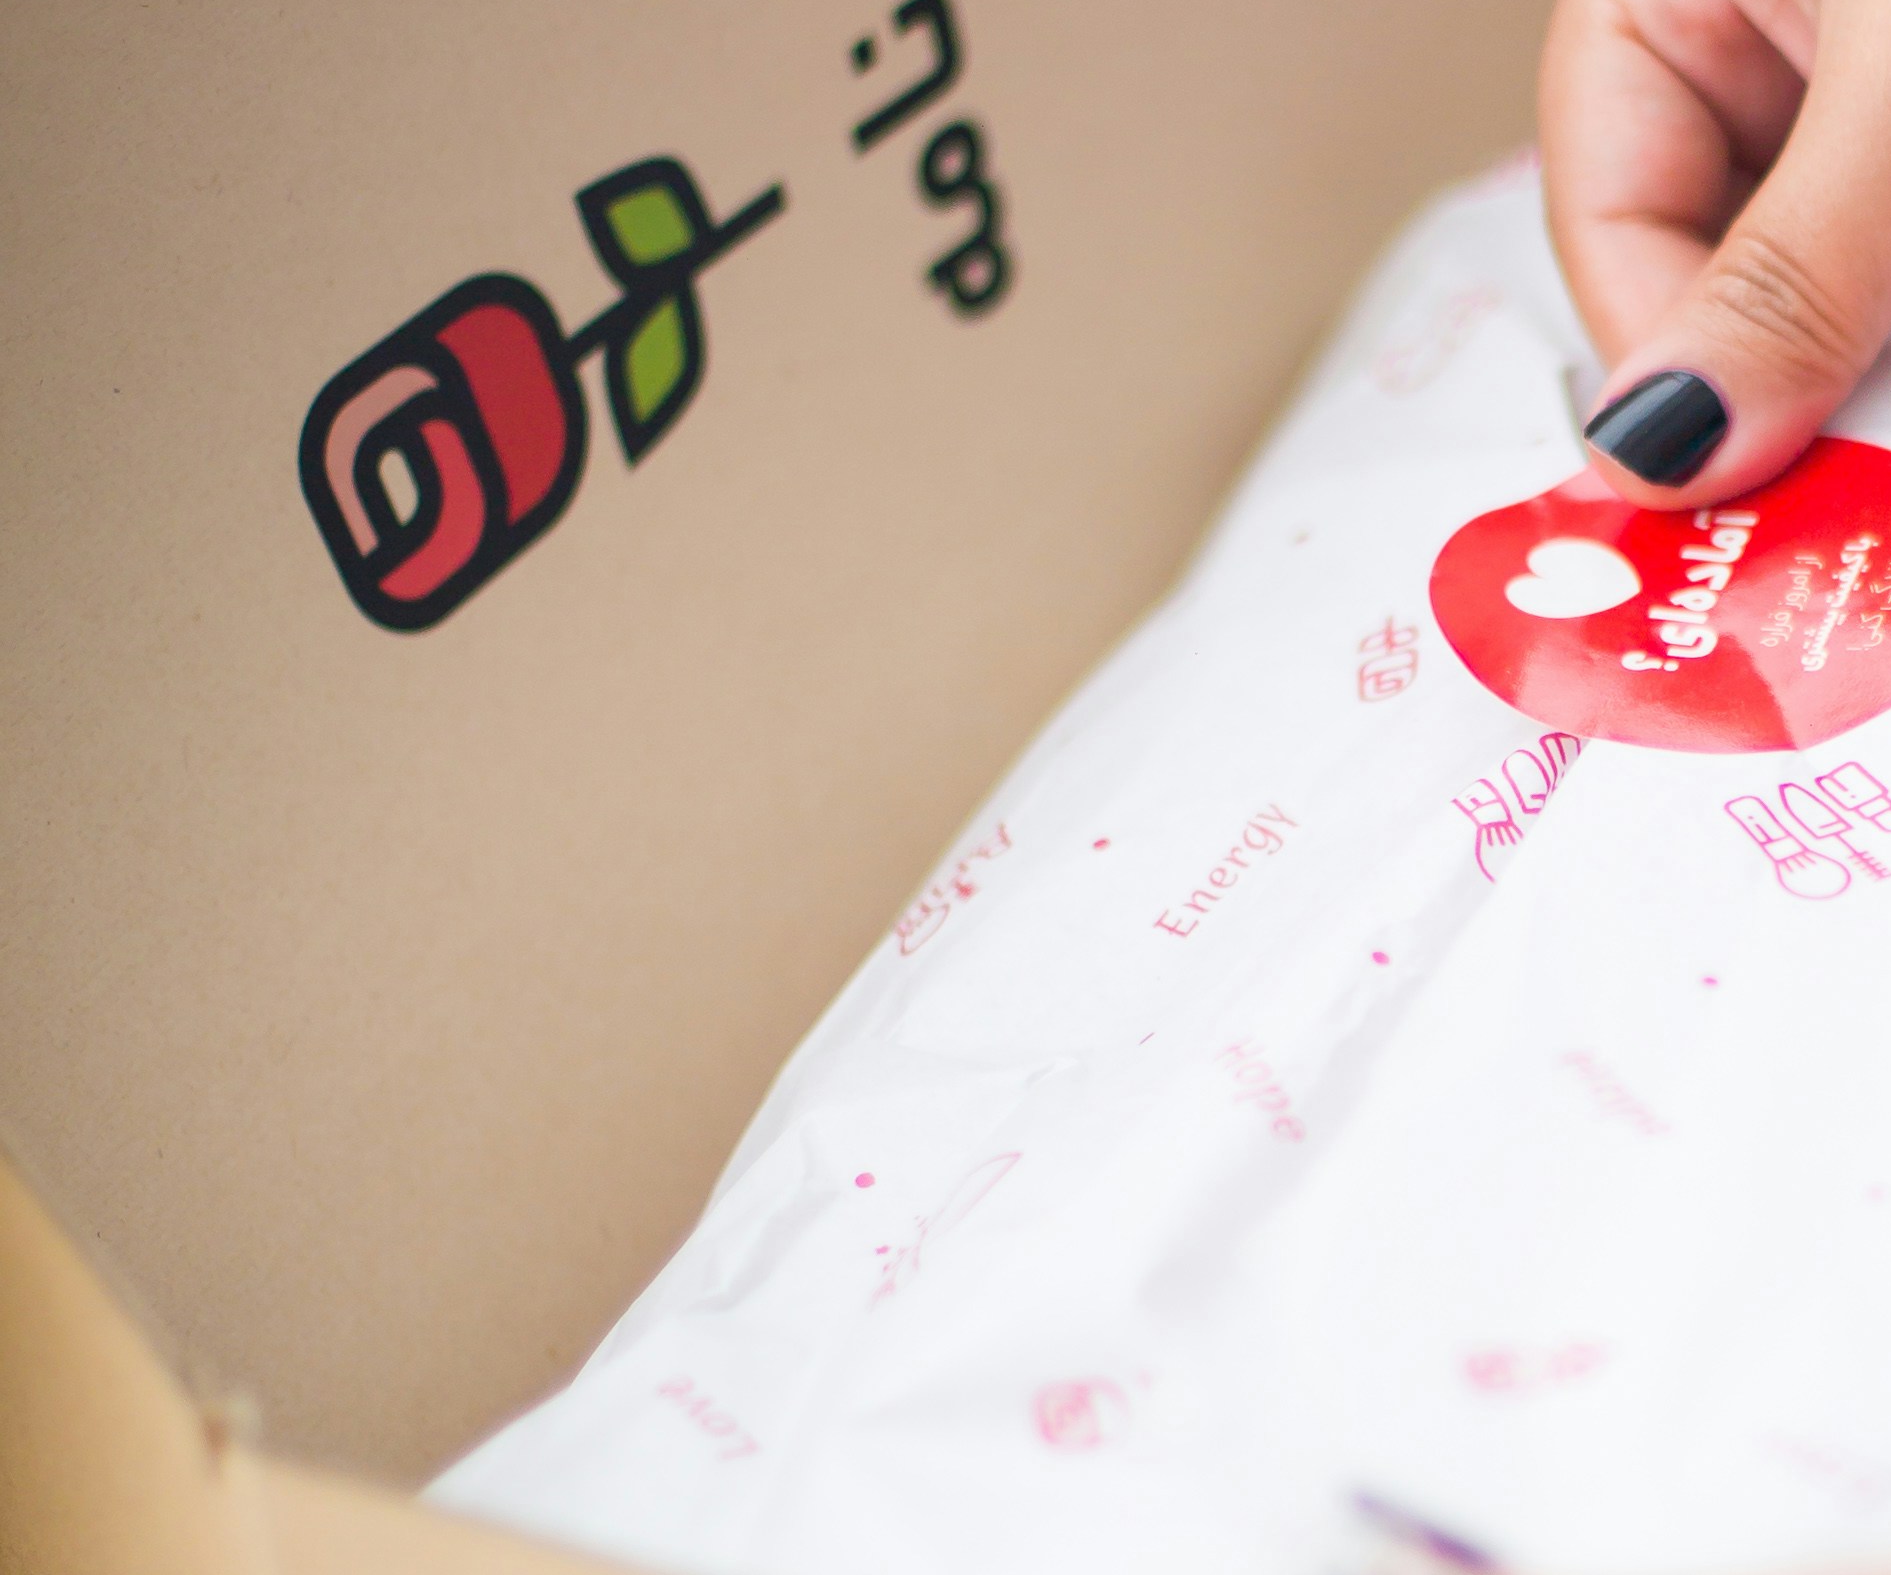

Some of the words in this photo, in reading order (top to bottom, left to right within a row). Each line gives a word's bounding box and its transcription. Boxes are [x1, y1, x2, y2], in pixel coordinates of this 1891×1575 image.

[1844, 535, 1880, 552] با
[1777, 569, 1812, 612] امروز
[1760, 610, 1793, 648] قراره
[1153, 802, 1300, 939] Energy
[1212, 1035, 1307, 1143] Hope
[655, 1374, 761, 1461] Love
